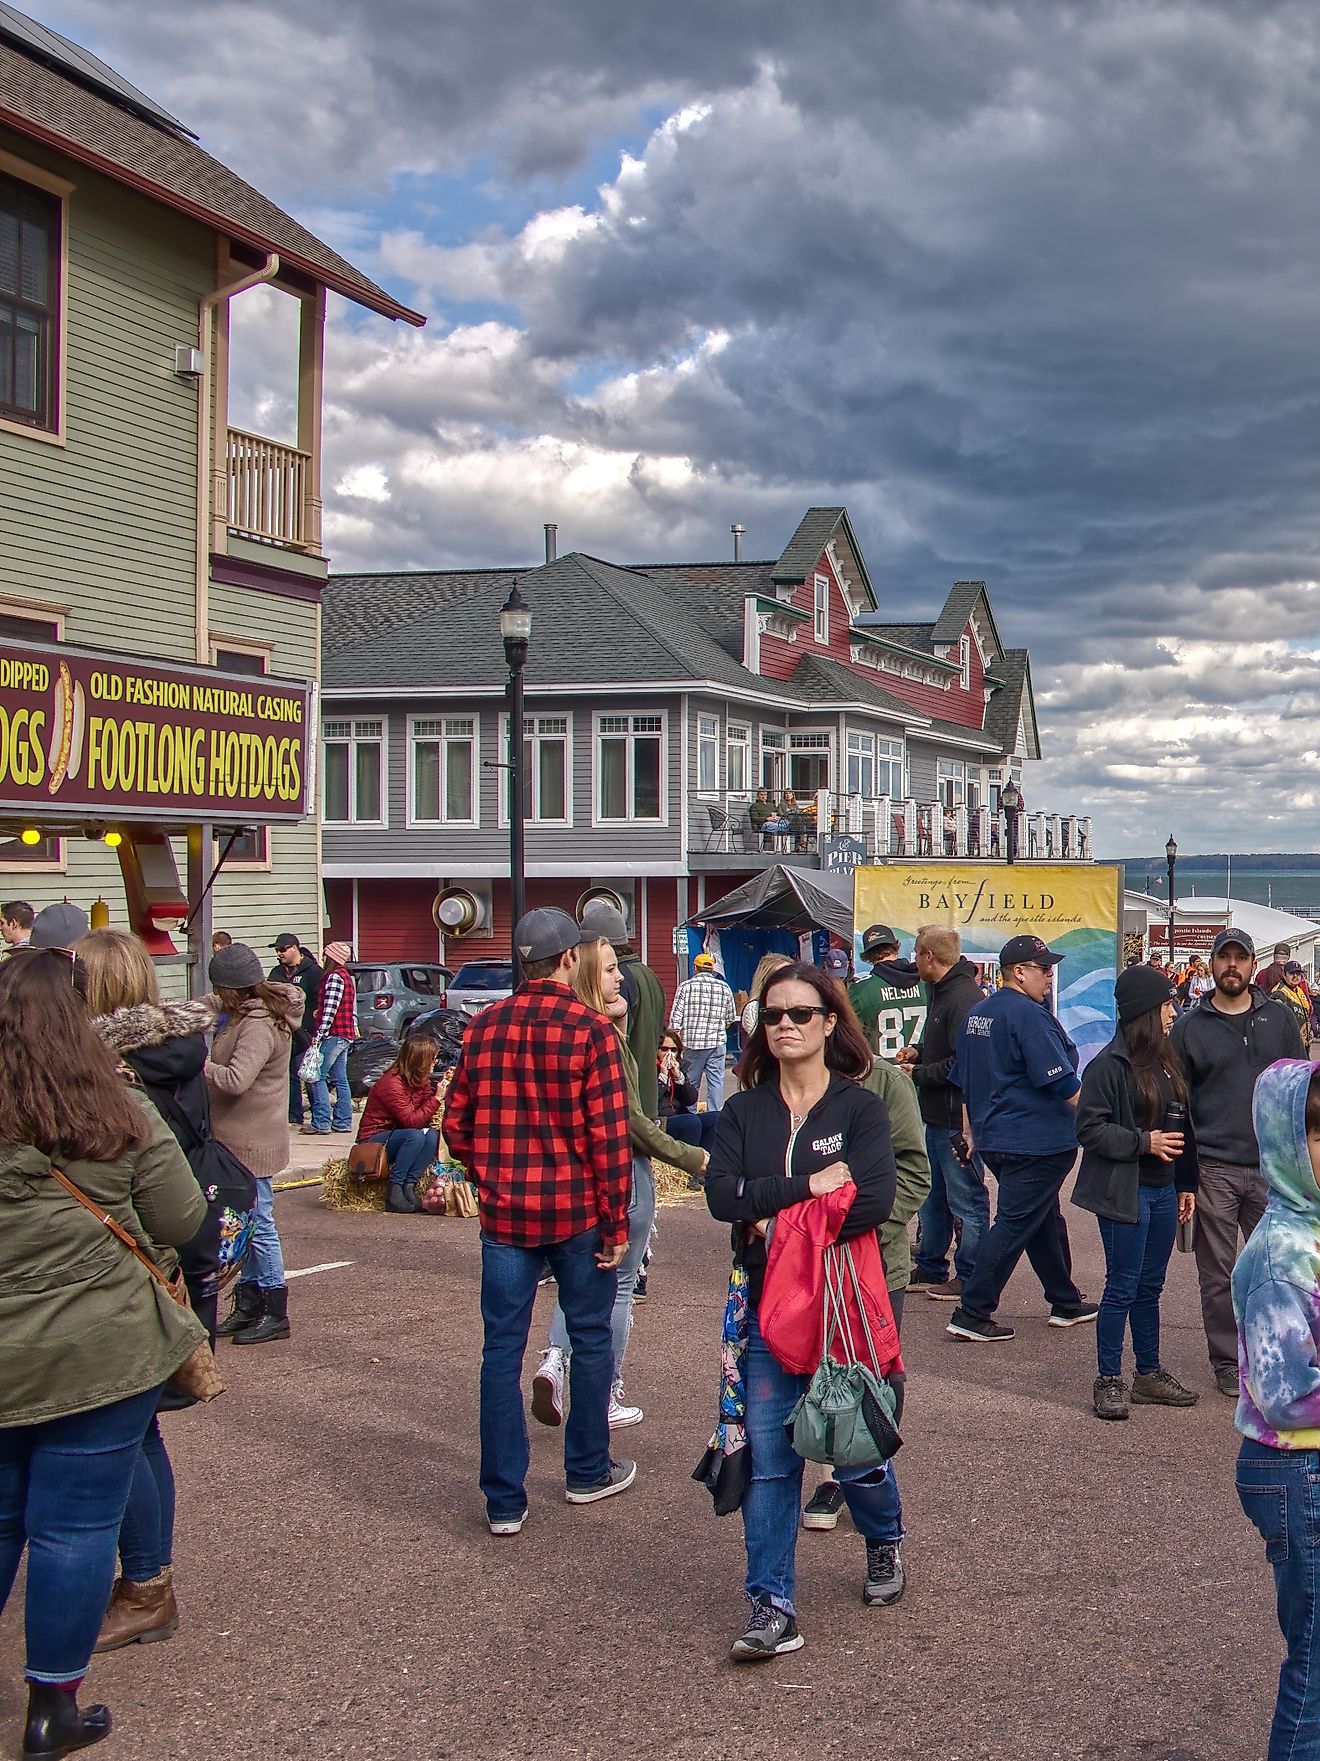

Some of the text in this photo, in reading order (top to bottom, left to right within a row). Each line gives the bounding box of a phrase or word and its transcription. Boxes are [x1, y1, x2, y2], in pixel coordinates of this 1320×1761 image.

[0, 659, 49, 692] DIPPED
[90, 671, 302, 723] OLD FASHION NATURAL CASING
[88, 716, 301, 801] FOOTLONG HOTDOGS
[828, 850, 863, 867] PIER
[979, 913, 1082, 927] and the apostle islands
[880, 985, 920, 1001] NELSON
[878, 1005, 928, 1058] 87
[1047, 1065, 1063, 1077] EMS
